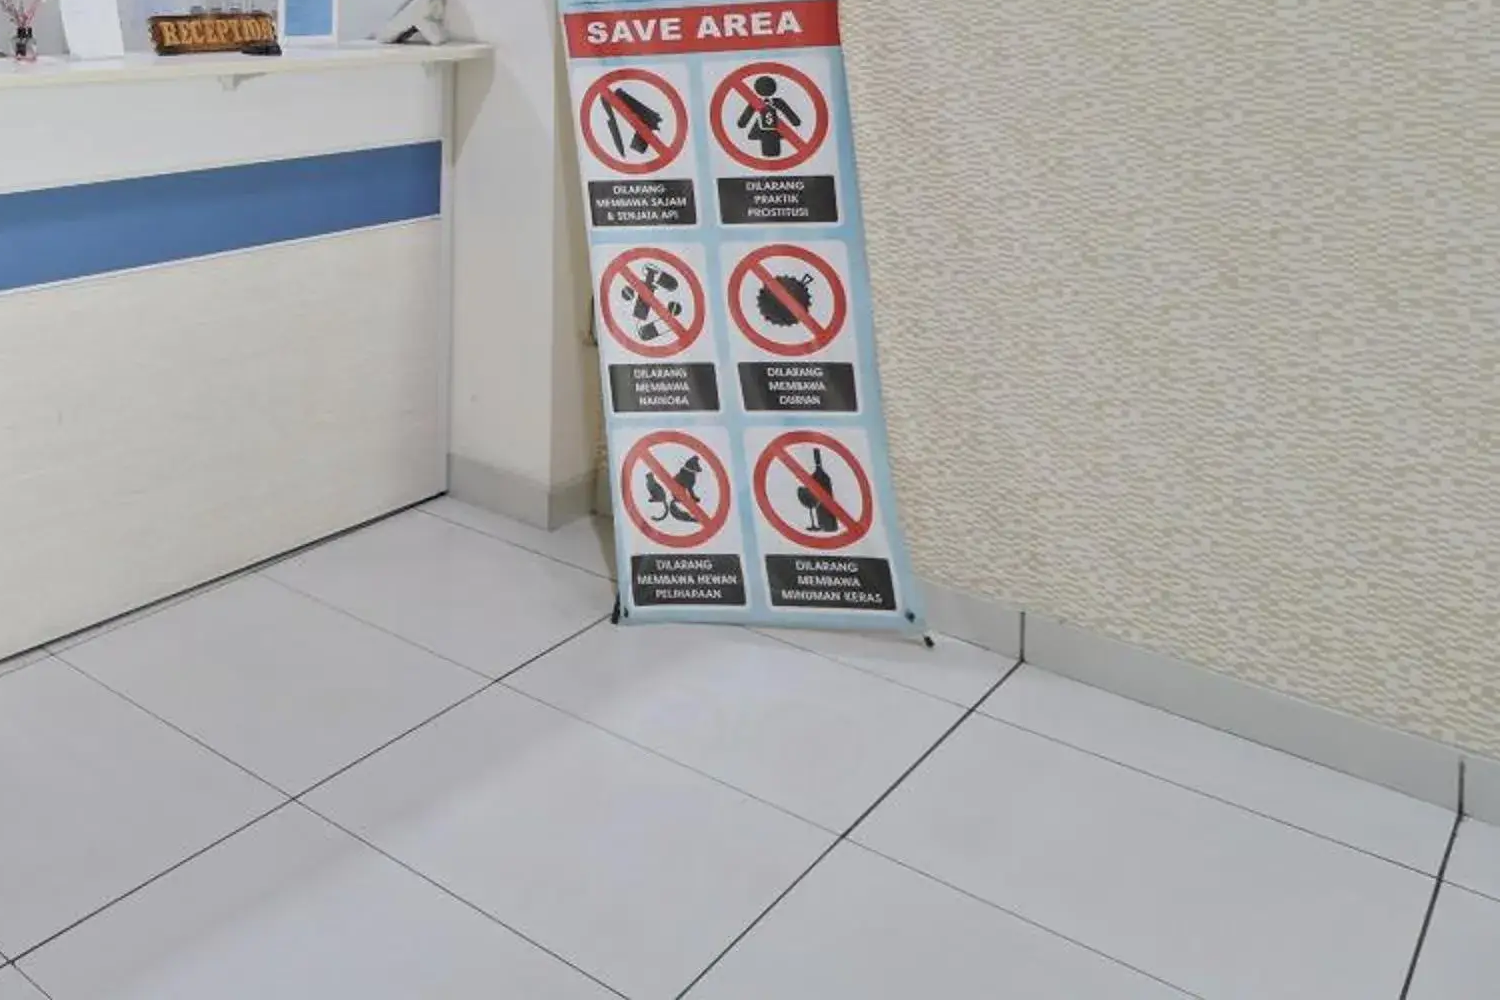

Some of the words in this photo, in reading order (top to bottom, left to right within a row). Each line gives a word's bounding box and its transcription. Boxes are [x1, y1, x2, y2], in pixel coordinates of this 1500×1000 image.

[159, 16, 273, 47] RECEPTION
[587, 17, 683, 44] SAVE
[696, 10, 803, 39] AREA
[746, 181, 805, 191] DILARANG
[651, 197, 687, 207] SAJAM
[753, 193, 799, 204] PRAKTIK
[747, 207, 809, 217] PROSTITUSI
[633, 368, 688, 379] DILARANG
[767, 367, 824, 377] DILARANG
[635, 381, 690, 392] MEMBAWA
[768, 381, 827, 391] MEMBAWA
[655, 559, 713, 570] DILARANG
[795, 559, 859, 572] DILARANG
[637, 574, 695, 585] MEMBAWA
[697, 574, 738, 585] HEWAN
[797, 575, 861, 587] MEMBAWA
[843, 591, 882, 604] KERAS
